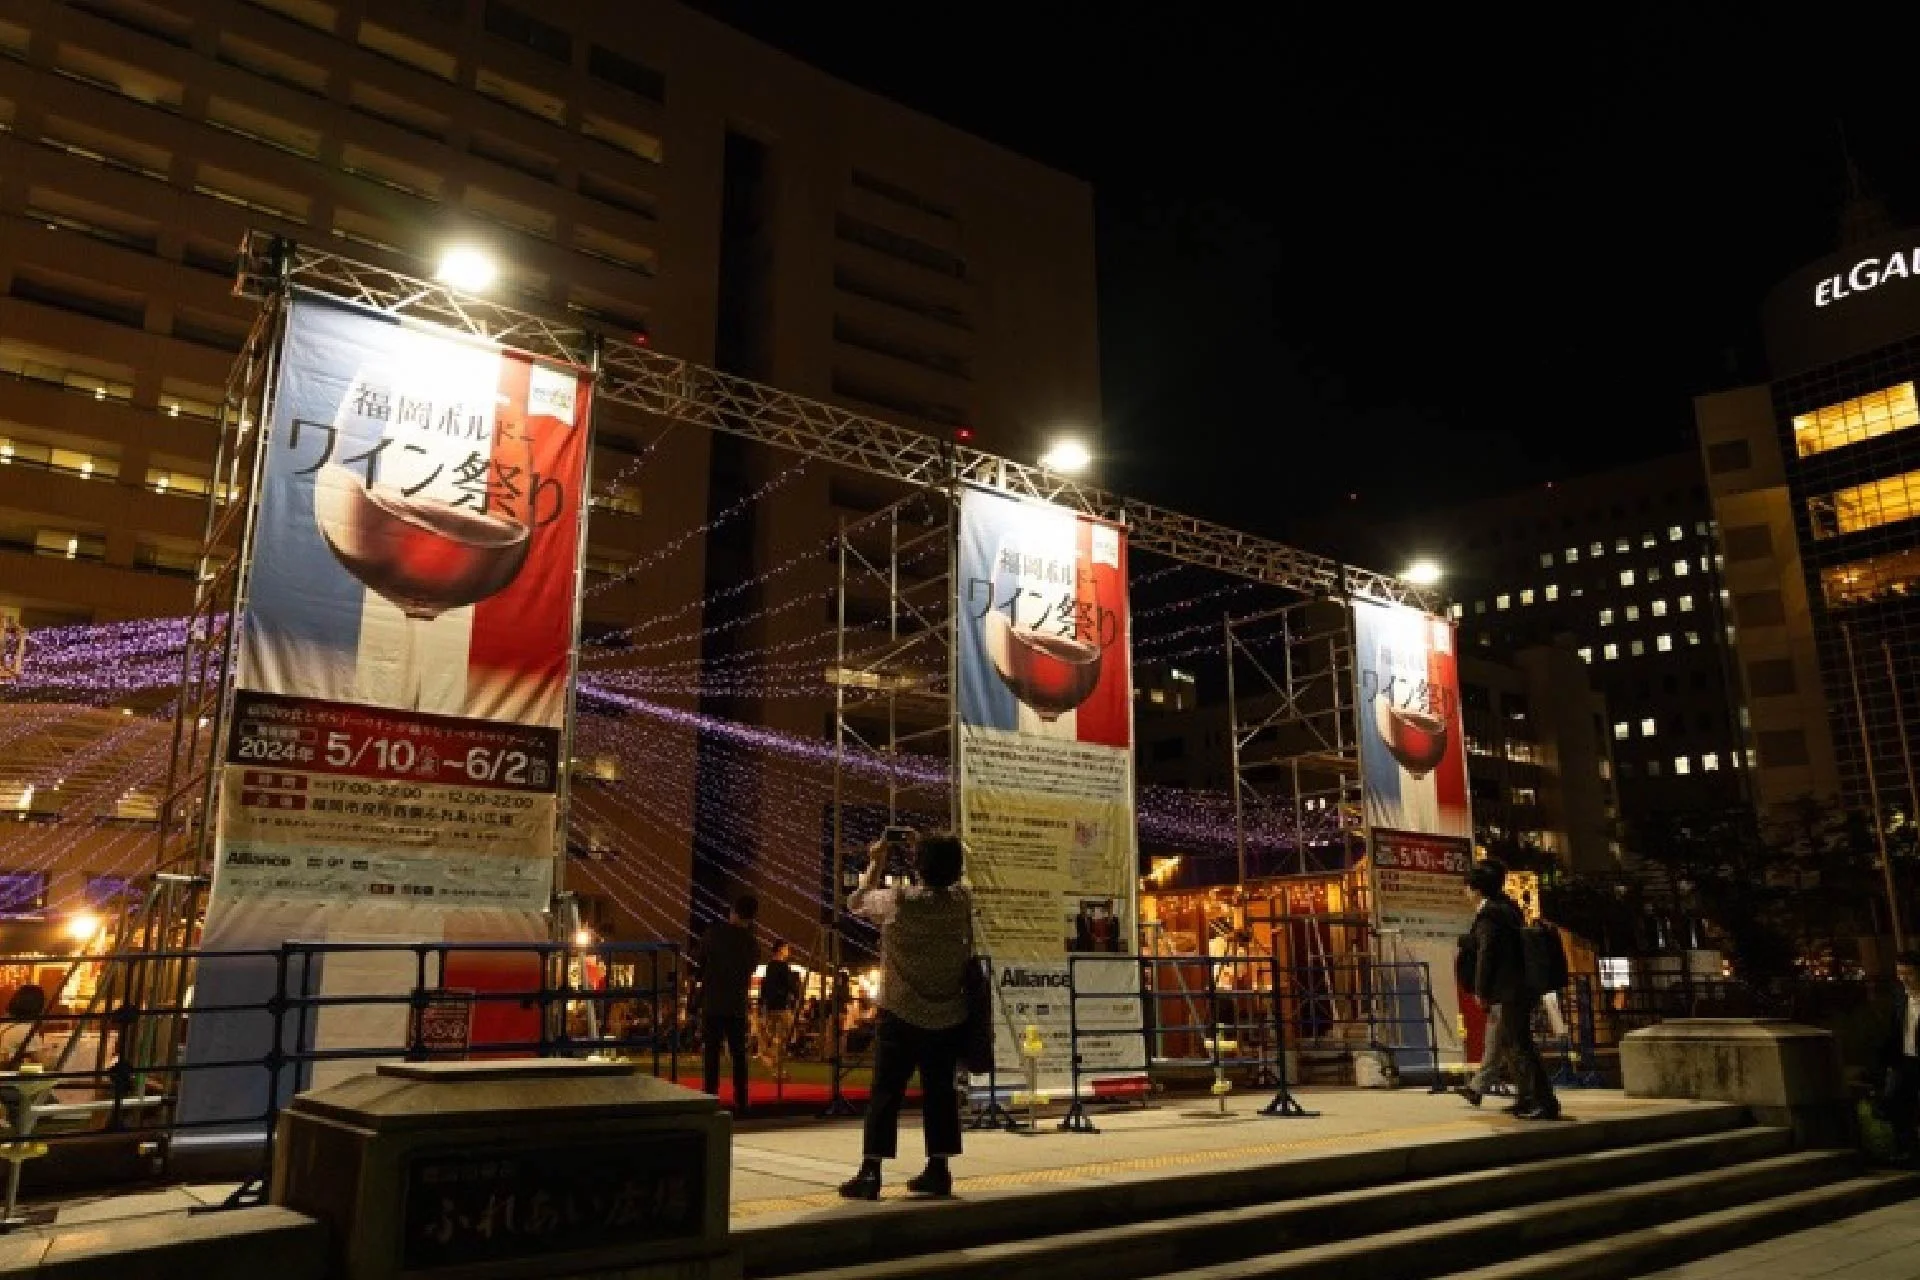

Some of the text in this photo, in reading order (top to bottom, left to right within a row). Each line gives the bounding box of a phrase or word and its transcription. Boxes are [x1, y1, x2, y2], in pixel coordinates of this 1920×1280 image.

[355, 381, 535, 446] 福岡ボルドー
[289, 418, 564, 528] ワイン祭り
[968, 577, 1116, 647] ワイン祭り
[225, 850, 291, 868] Alliance
[1000, 967, 1072, 988] Alliance
